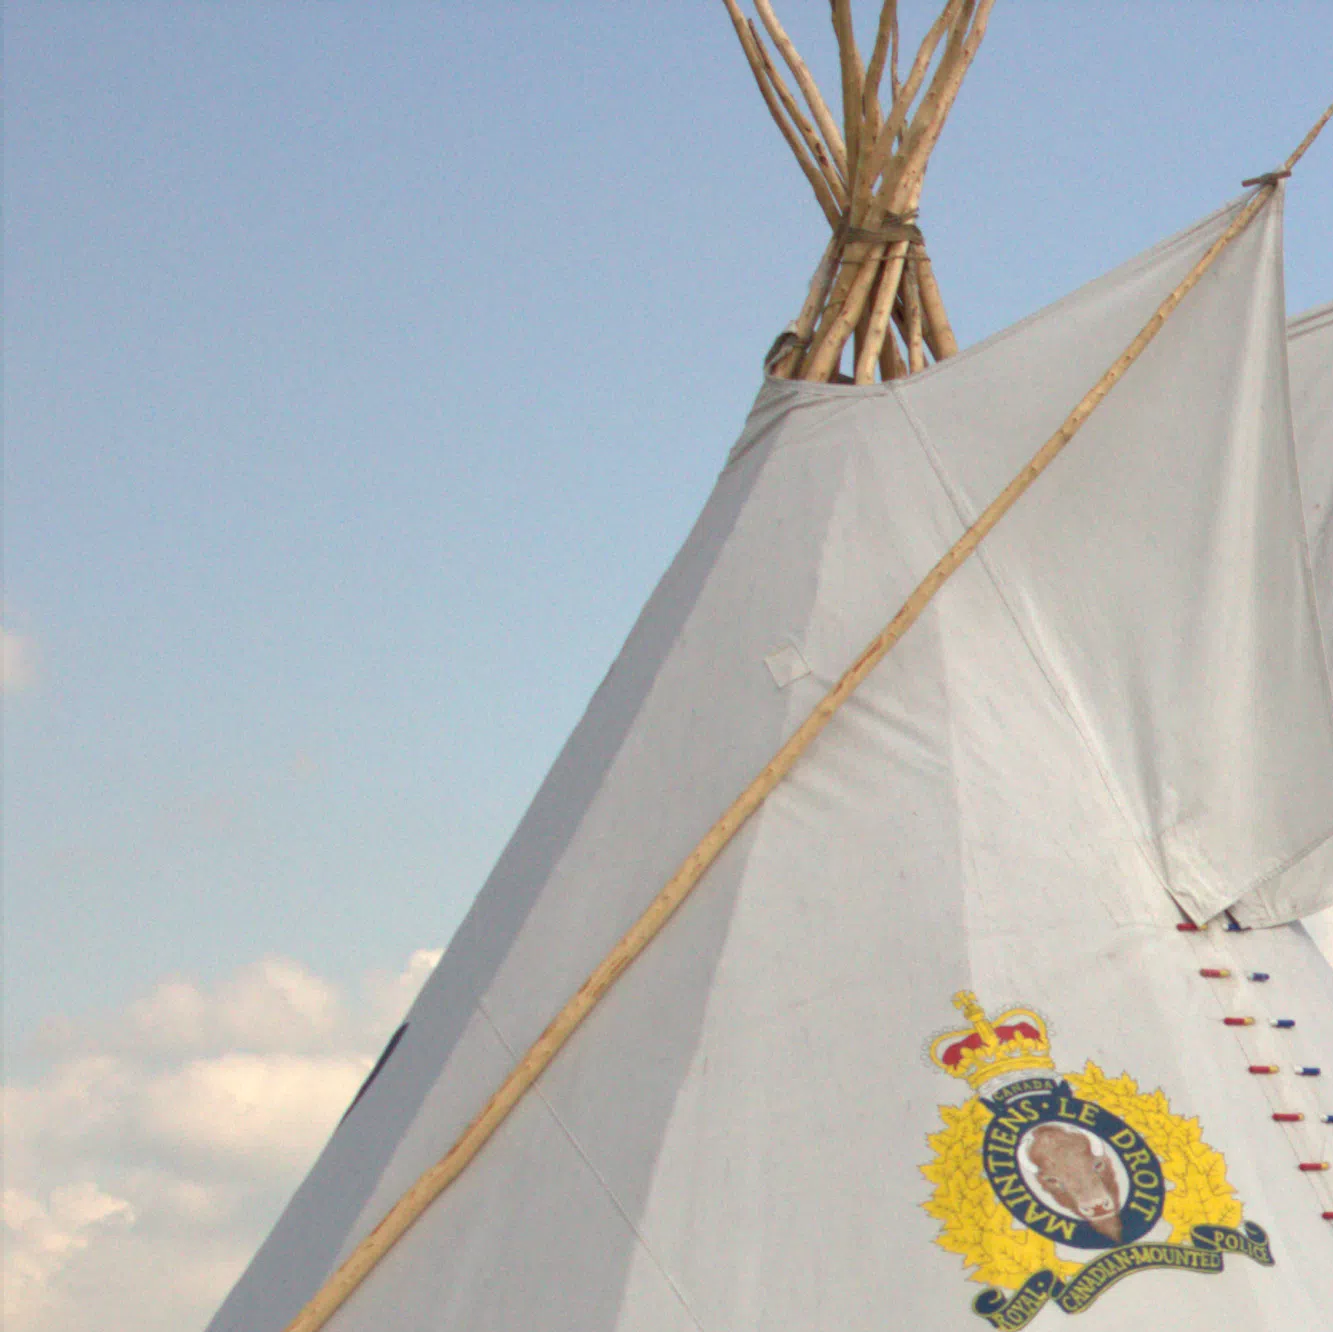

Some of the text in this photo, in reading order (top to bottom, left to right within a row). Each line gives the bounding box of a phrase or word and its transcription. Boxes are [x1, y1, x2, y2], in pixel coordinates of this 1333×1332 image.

[992, 1080, 1055, 1101] CANADA
[988, 1097, 1160, 1241] MAINTIENS LE DROIT
